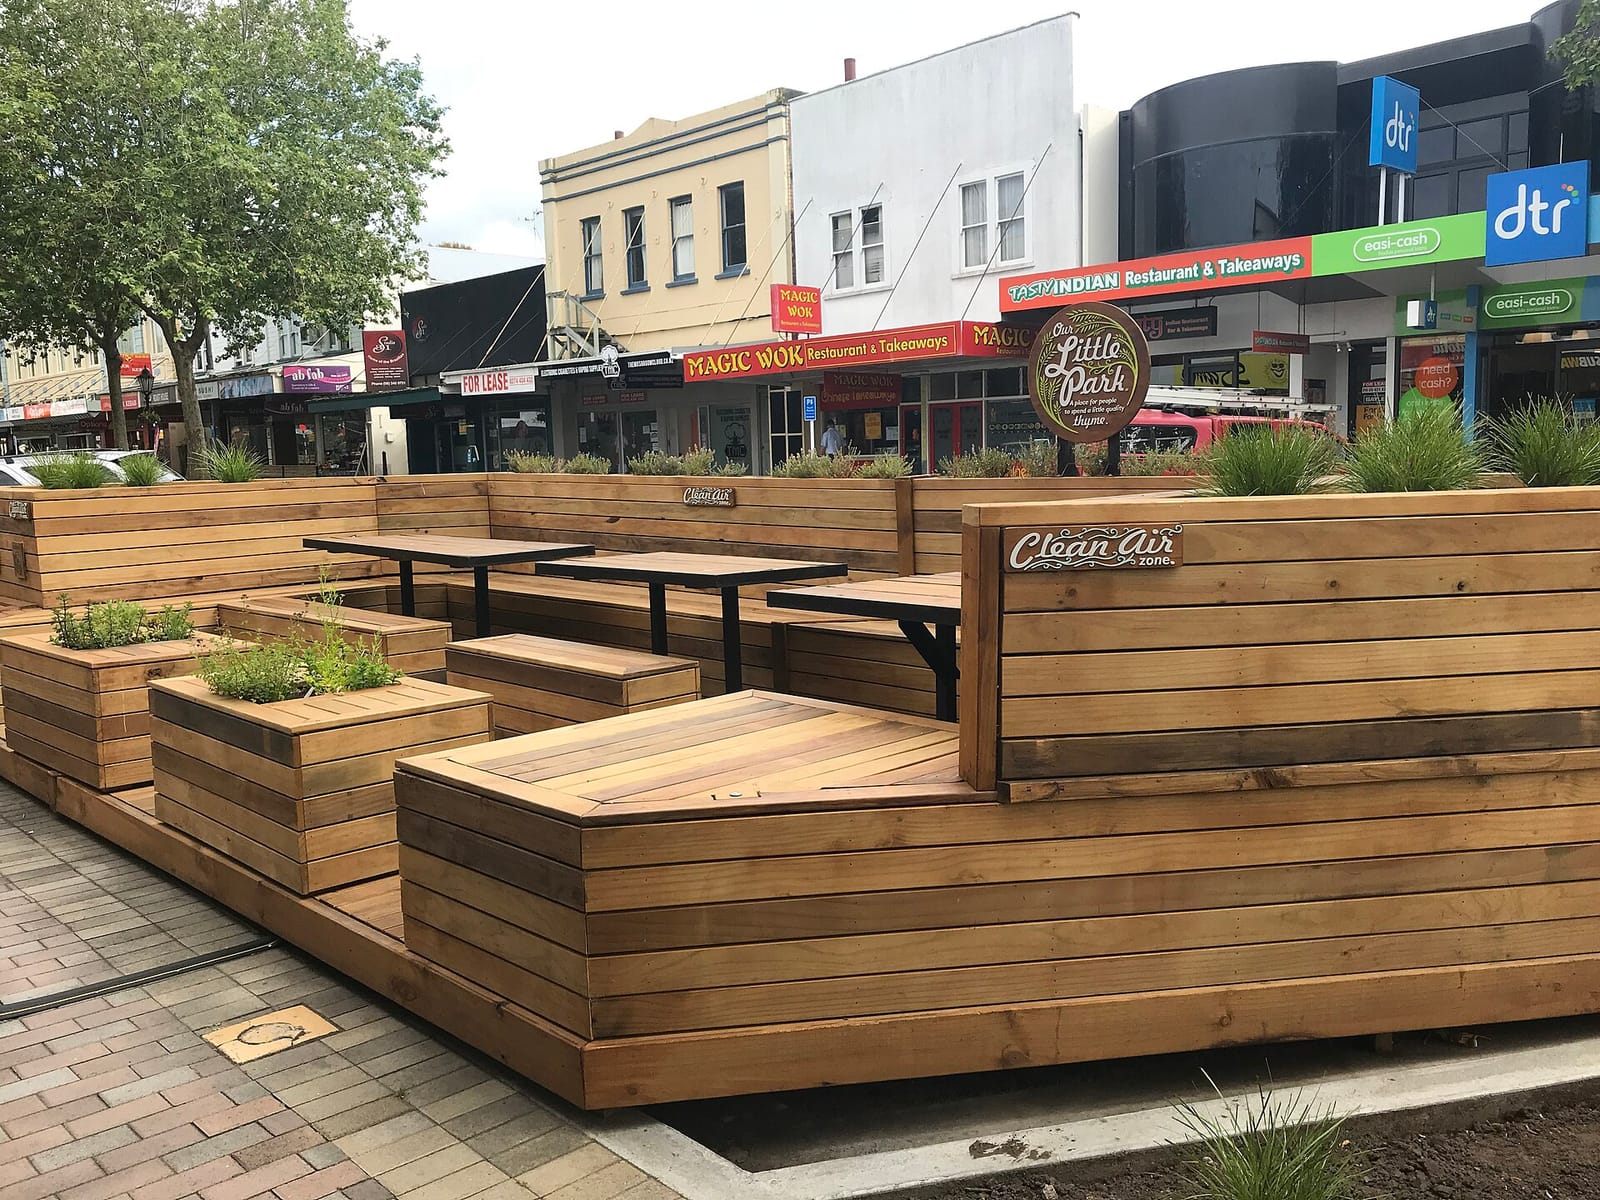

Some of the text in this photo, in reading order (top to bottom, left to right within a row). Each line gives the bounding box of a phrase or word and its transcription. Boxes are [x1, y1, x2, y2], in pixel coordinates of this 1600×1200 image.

[1386, 101, 1411, 152] dtr
[1495, 184, 1571, 240] dtr
[1364, 232, 1428, 252] easi-cash
[1125, 266, 1200, 287] Restaurant
[1203, 261, 1214, 276] &
[1217, 253, 1302, 276] Takeaways
[781, 290, 818, 303] MAGIC
[1496, 292, 1560, 310] easi-cash
[788, 305, 813, 318] WOK
[973, 325, 1030, 347] MAGIC
[1053, 322, 1073, 337] Our
[807, 335, 948, 361] Restaurant & Takeaways
[1045, 333, 1120, 378] Little
[688, 345, 804, 377] MAGIC WOK
[1423, 363, 1450, 375] need
[292, 369, 305, 381] ab
[306, 367, 324, 381] fab
[463, 375, 480, 393] FOR
[482, 372, 509, 392] LEASE
[832, 374, 893, 386] MAGIC WOK
[1421, 377, 1452, 388] cash?
[1098, 397, 1117, 405] people
[1105, 405, 1125, 413] quality
[683, 487, 730, 503] Clean Air
[1010, 528, 1174, 569] Clean Air
